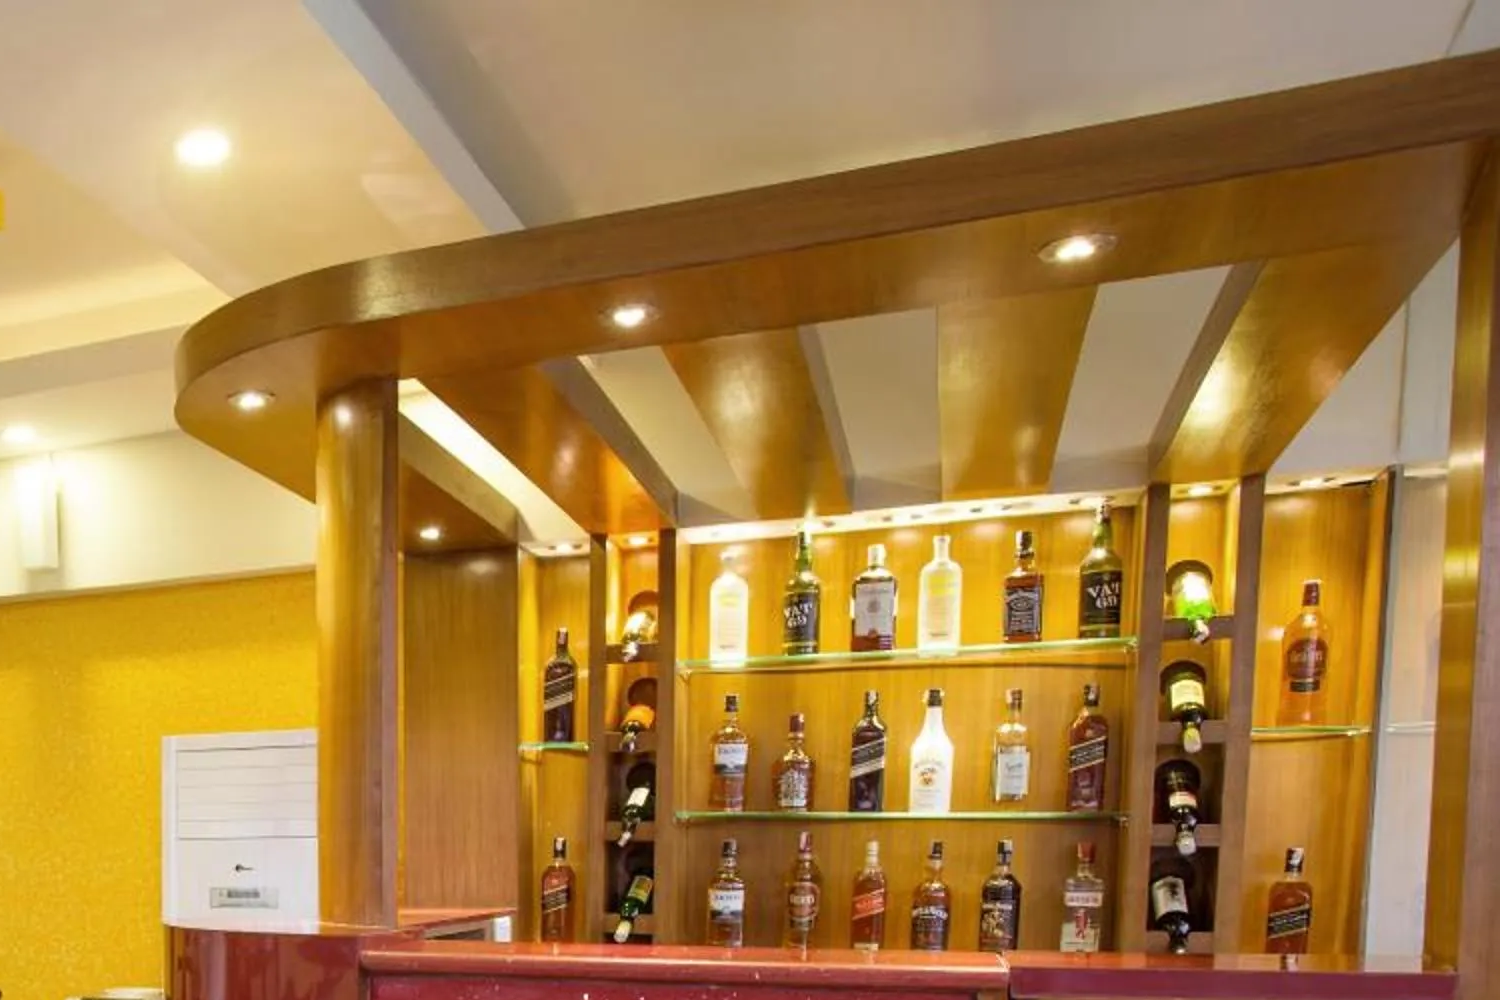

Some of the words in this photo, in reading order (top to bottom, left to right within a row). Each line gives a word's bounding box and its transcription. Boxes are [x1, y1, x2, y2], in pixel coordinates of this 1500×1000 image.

[1087, 582, 1120, 598] VAT
[1095, 595, 1118, 609] 69
[783, 602, 813, 618] VAT
[787, 615, 807, 629] 69
